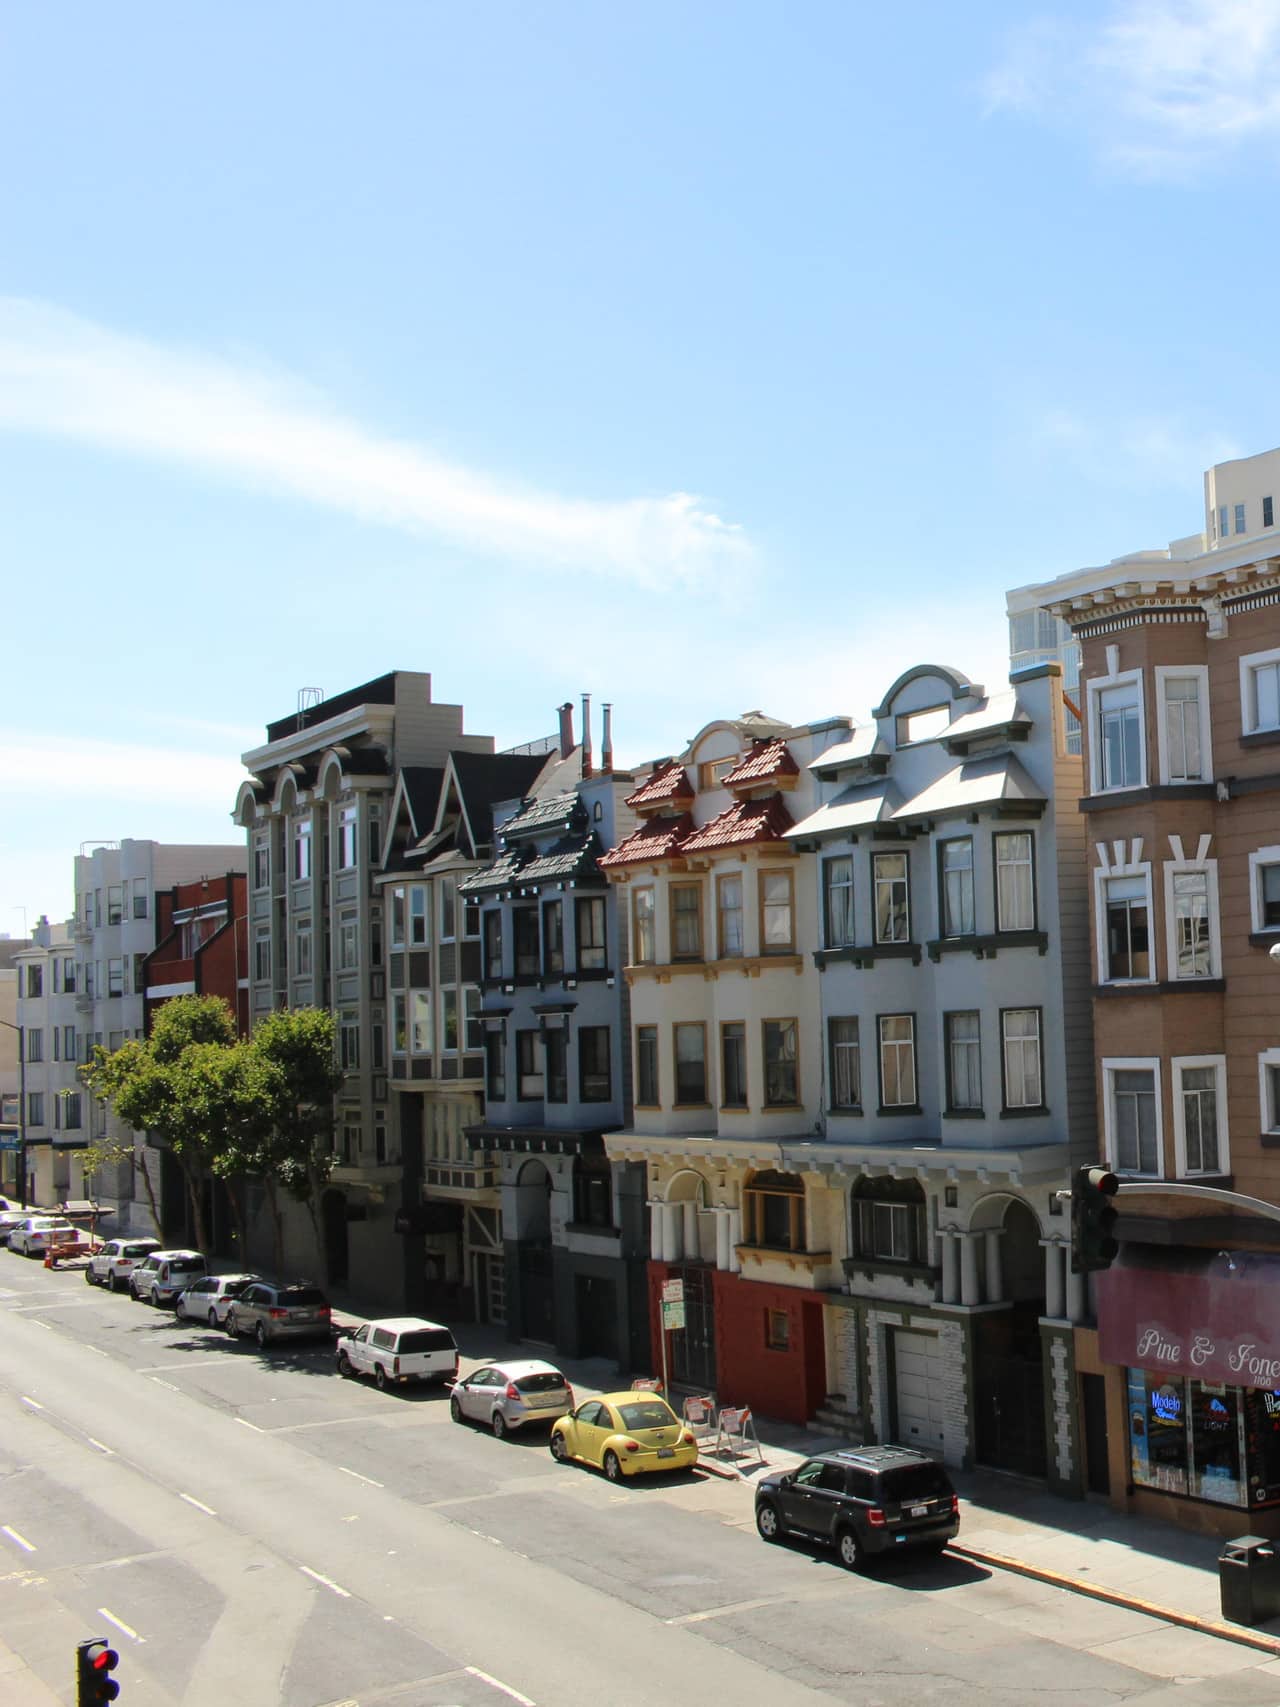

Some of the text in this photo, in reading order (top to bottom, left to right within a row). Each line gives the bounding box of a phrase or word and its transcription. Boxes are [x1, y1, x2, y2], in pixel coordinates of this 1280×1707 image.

[1137, 1329, 1180, 1362] Pine
[1190, 1336, 1215, 1366] &
[1253, 1375, 1272, 1386] 1100
[1152, 1391, 1181, 1411] Modelo
